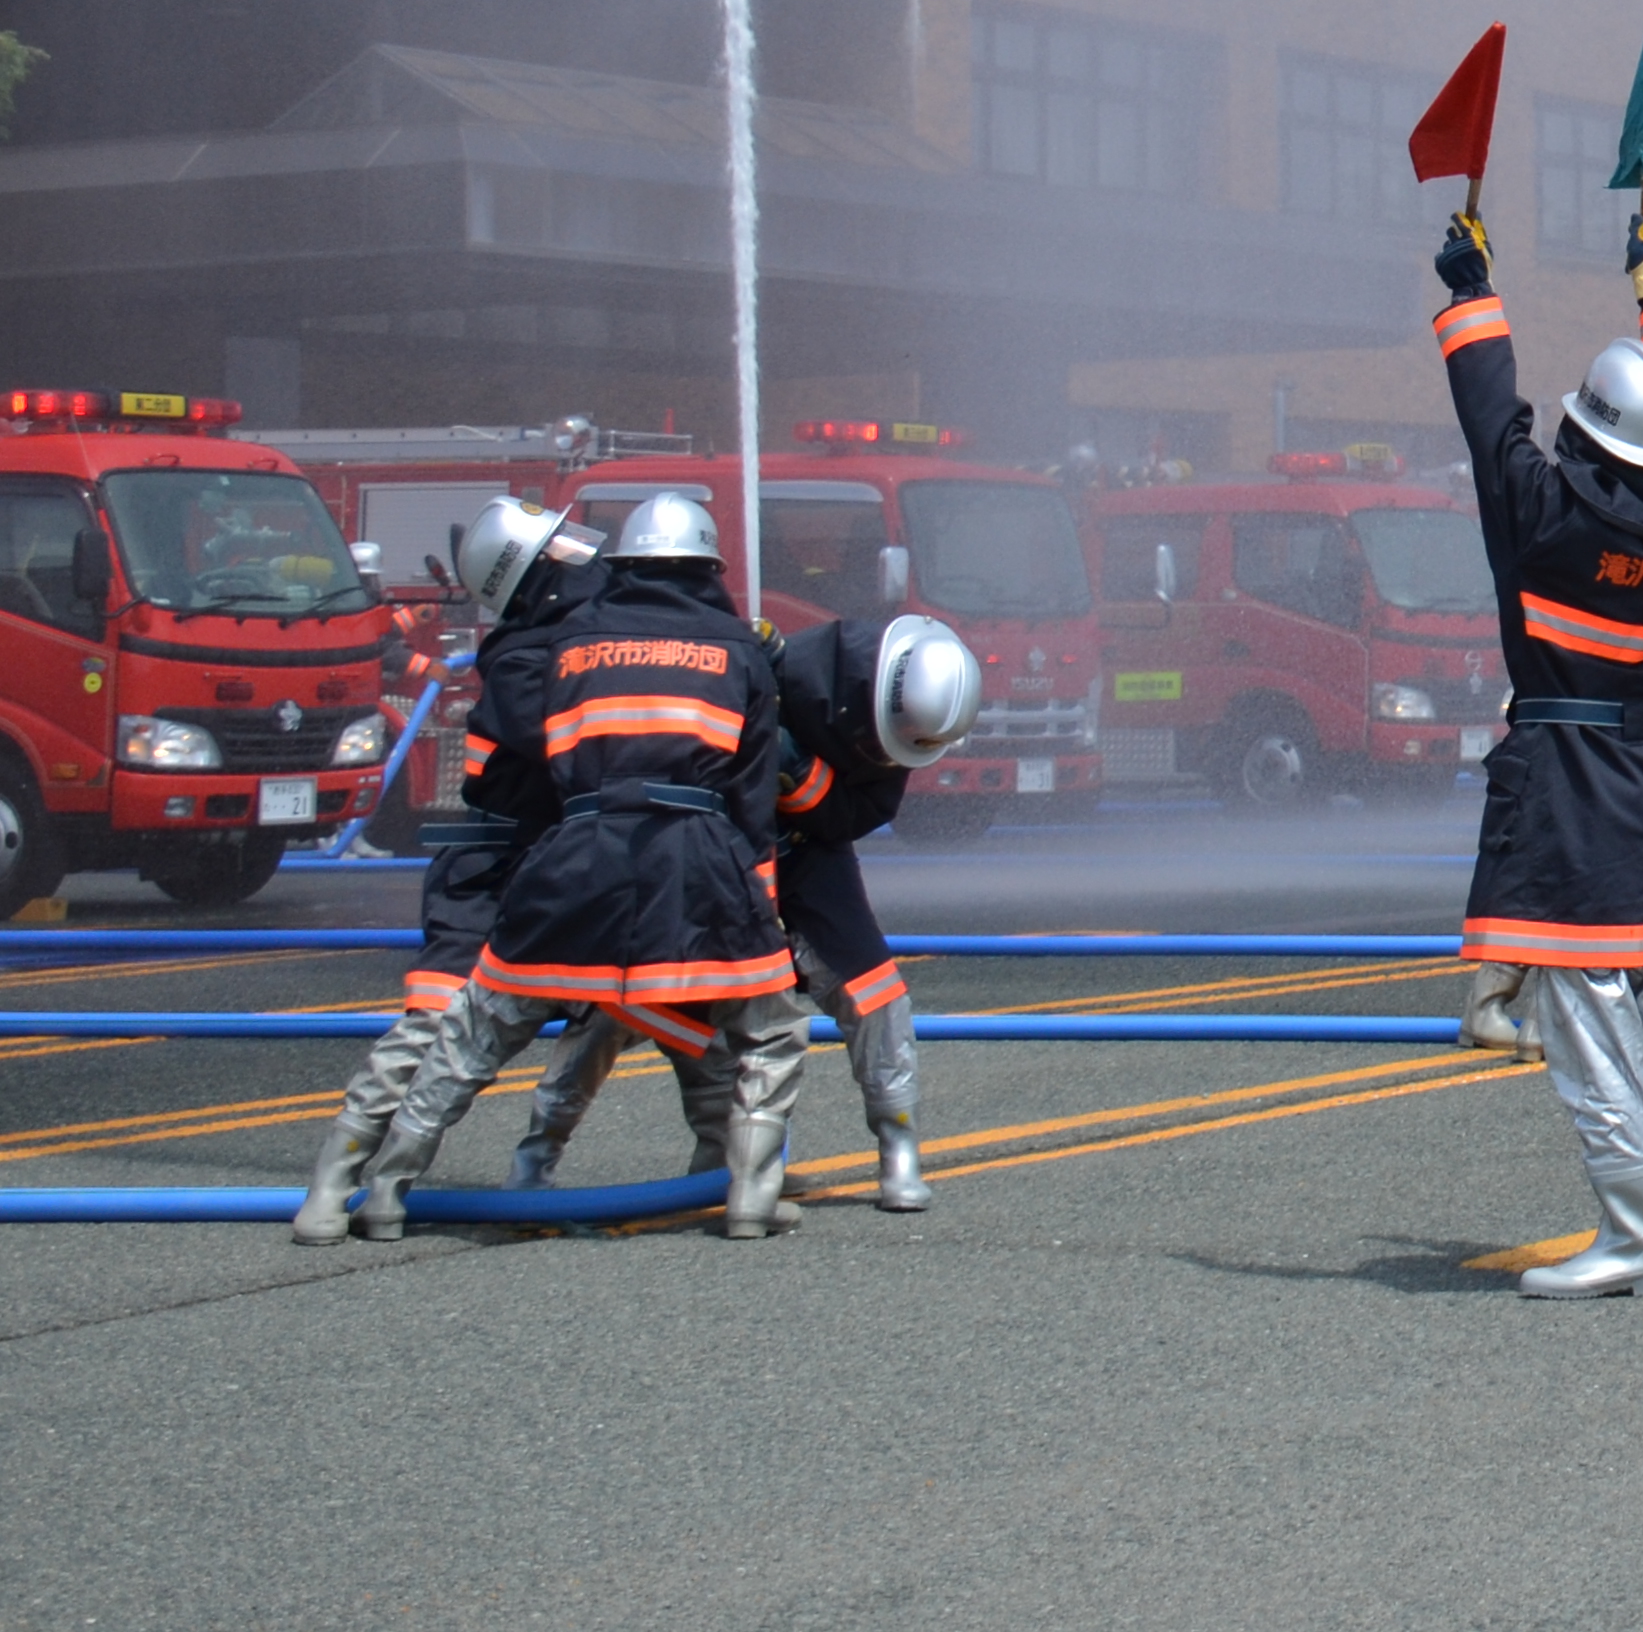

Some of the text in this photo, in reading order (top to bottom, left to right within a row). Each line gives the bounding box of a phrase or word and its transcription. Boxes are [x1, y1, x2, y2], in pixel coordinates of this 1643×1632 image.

[480, 539, 524, 598] 滝沢市消防団
[558, 639, 728, 679] 滝沢市消防団
[292, 797, 307, 815] 21
